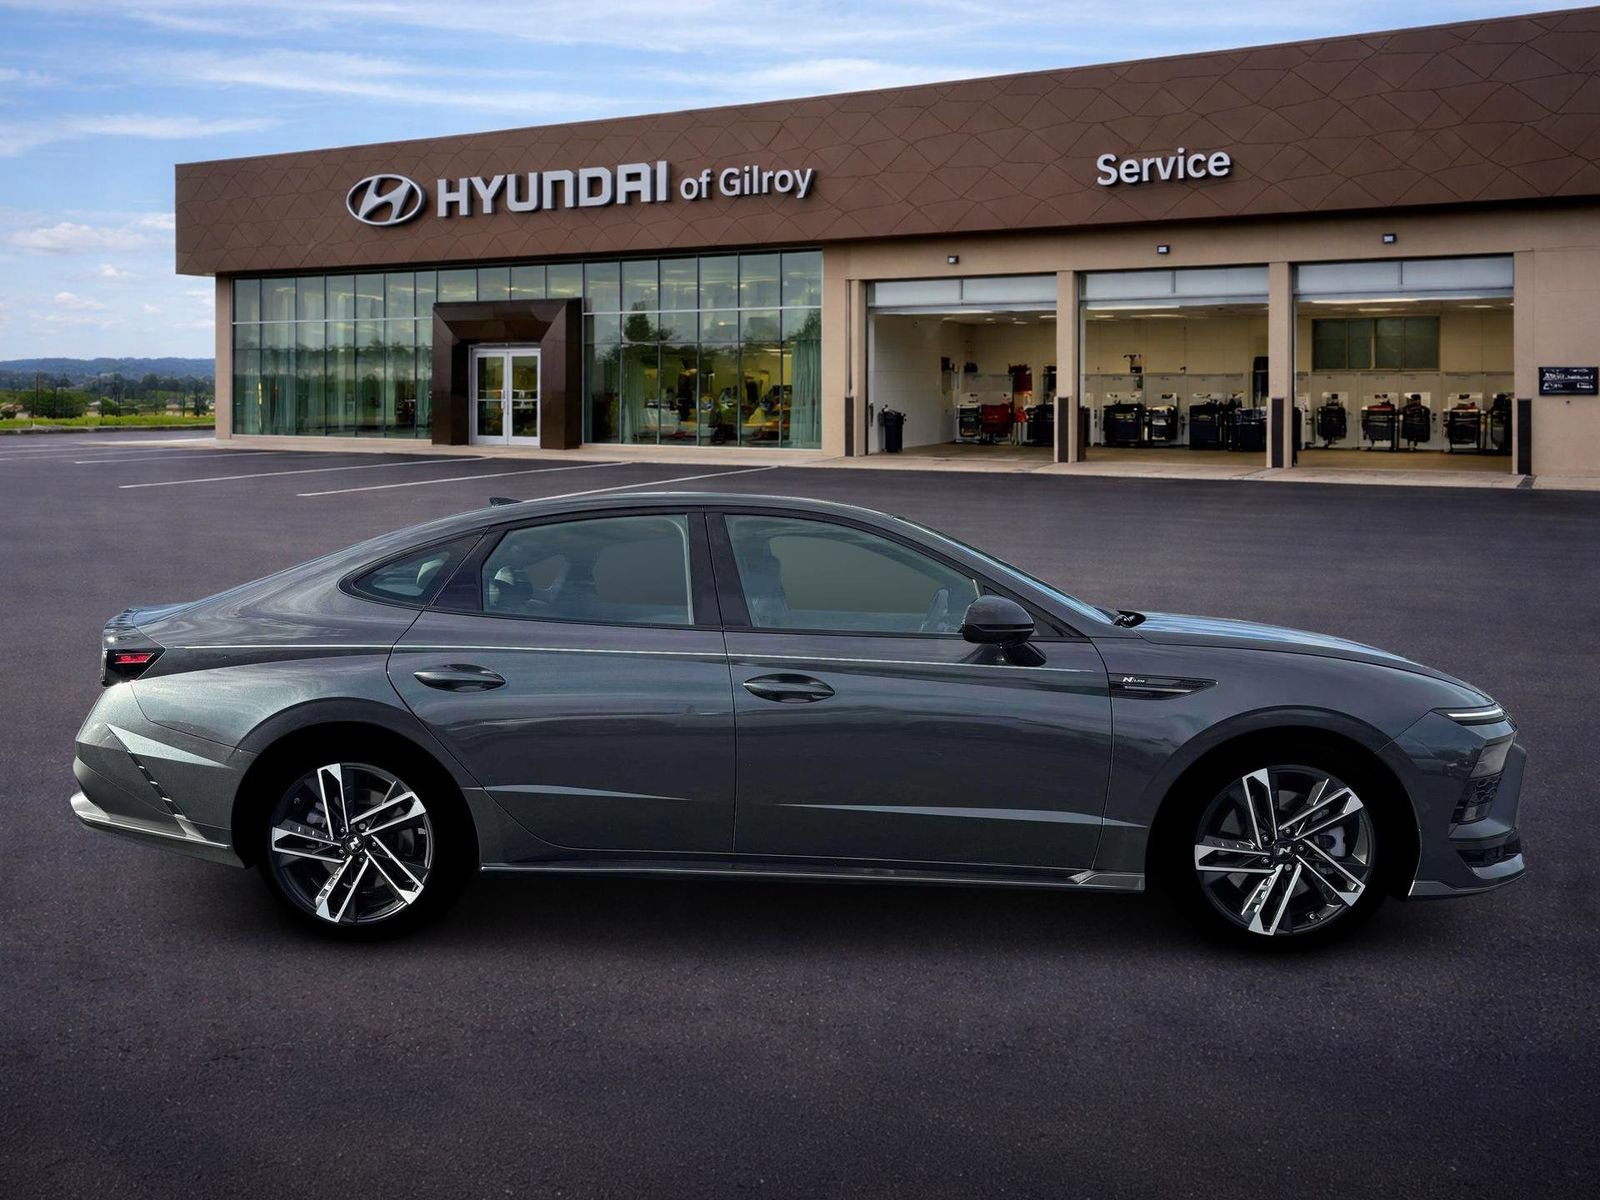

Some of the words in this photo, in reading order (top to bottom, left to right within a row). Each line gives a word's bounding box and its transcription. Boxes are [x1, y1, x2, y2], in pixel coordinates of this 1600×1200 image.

[436, 160, 669, 218] HYUNDAI
[680, 168, 712, 200] of
[719, 164, 813, 199] Gilroy
[1096, 147, 1232, 187] Service
